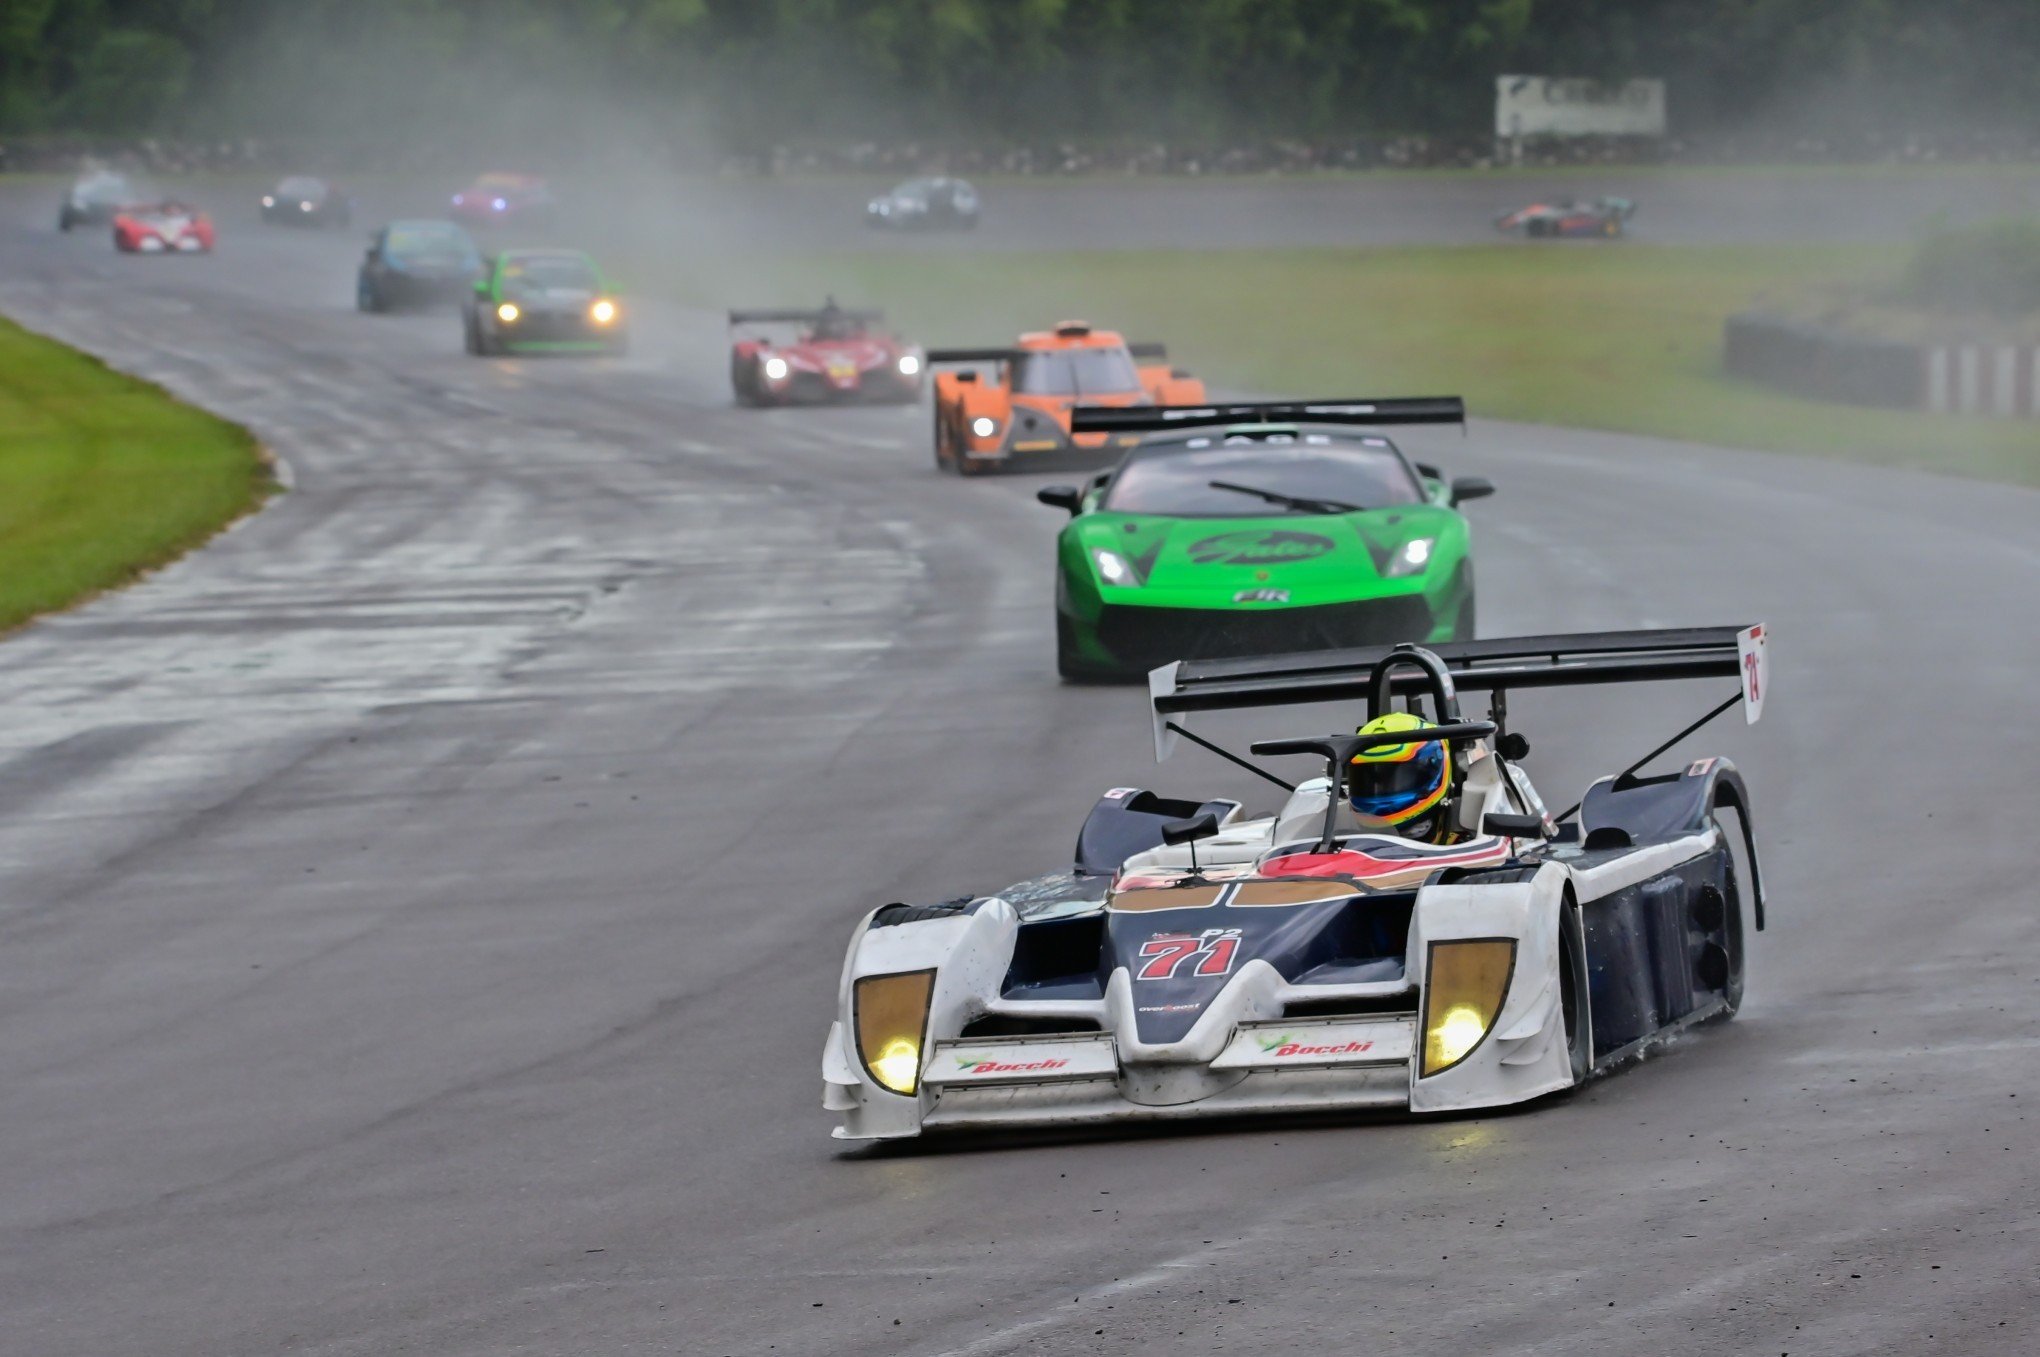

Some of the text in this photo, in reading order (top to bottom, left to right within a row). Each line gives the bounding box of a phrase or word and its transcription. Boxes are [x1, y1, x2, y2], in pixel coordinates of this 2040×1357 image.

[1200, 928, 1243, 938] P2
[1136, 937, 1242, 980] 71
[1275, 1041, 1374, 1056] Bocchi
[971, 1059, 1071, 1073] Bocchi
